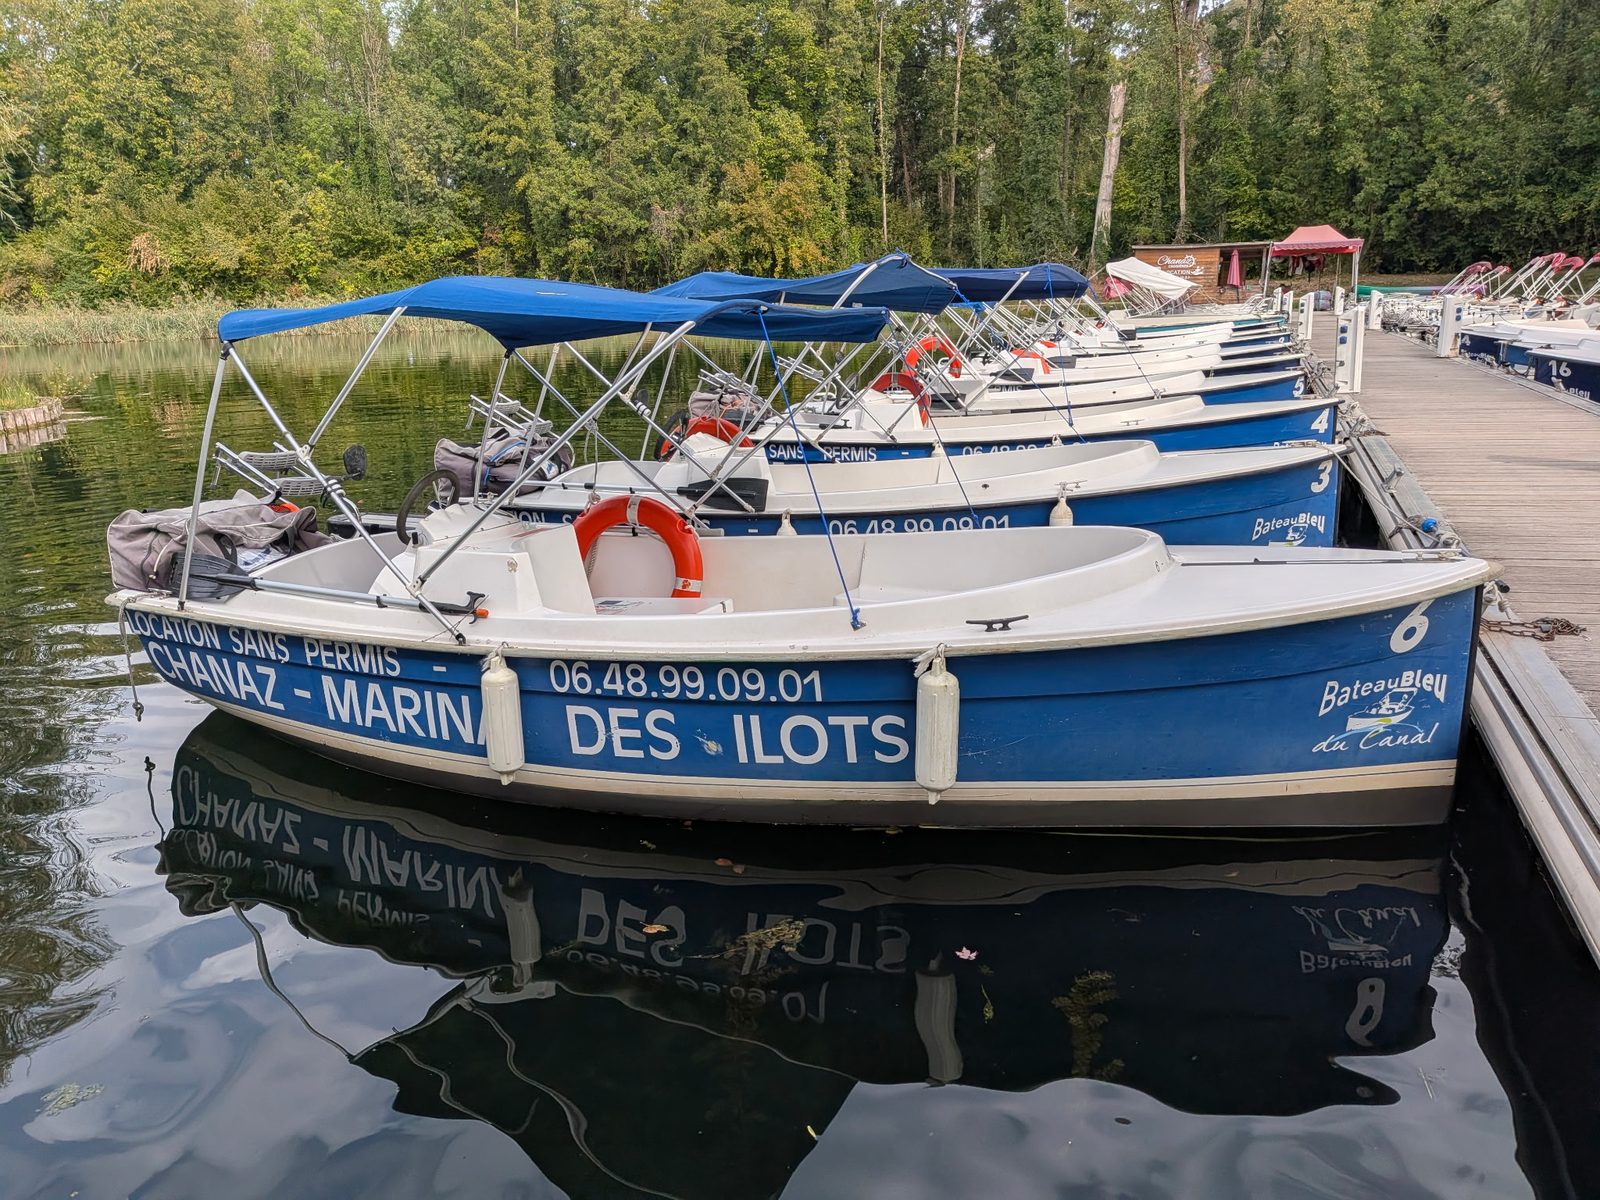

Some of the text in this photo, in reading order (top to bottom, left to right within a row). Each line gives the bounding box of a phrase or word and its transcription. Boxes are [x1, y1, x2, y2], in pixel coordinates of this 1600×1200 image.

[1549, 359, 1572, 377] 16
[1293, 376, 1305, 397] 5
[1311, 407, 1330, 433] 4
[768, 444, 804, 460] SANS
[823, 446, 877, 461] PERMIS
[1310, 459, 1332, 494] 3
[1389, 598, 1436, 654] 6
[129, 610, 222, 650] LOCATION
[228, 626, 290, 663] SANS
[304, 637, 401, 677] PERMIS
[549, 659, 825, 703] 06.48.99.09.01
[148, 641, 286, 711] CHANAZ
[565, 705, 681, 762] DES
[733, 714, 910, 766] ILOTS
[1359, 722, 1439, 750] Canal
